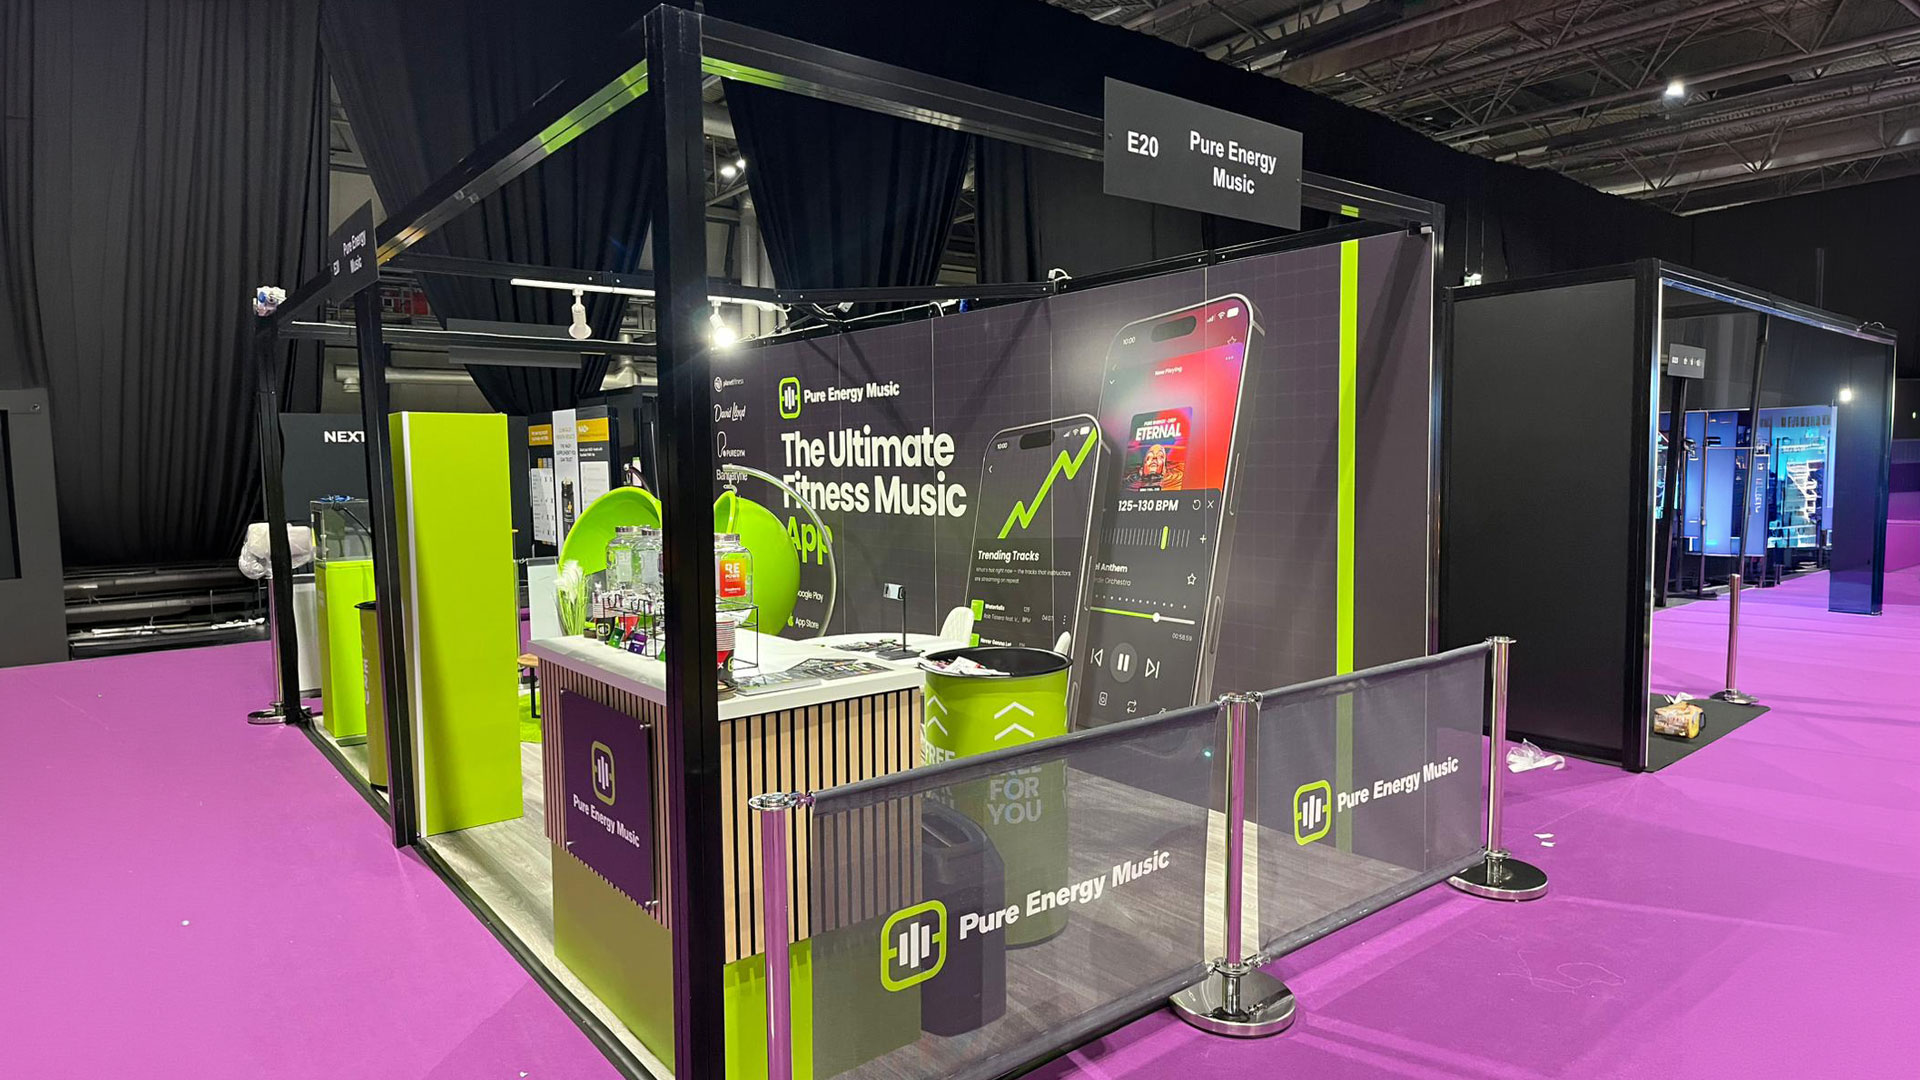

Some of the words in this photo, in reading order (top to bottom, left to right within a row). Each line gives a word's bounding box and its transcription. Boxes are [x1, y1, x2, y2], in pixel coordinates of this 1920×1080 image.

[1127, 130, 1159, 158] E20
[1189, 130, 1225, 158] Pure
[1228, 140, 1277, 175] Energy
[1213, 166, 1256, 194] Music
[803, 389, 826, 403] Pure
[828, 385, 864, 403] Energy
[866, 381, 900, 398] Music
[713, 403, 732, 422] David
[731, 402, 746, 421] Lloyd
[1135, 422, 1182, 441] ETERNAL
[781, 431, 825, 468] The
[828, 424, 955, 468] Ultimate
[782, 470, 870, 512] Fitness
[874, 470, 967, 517] Music
[1155, 500, 1179, 512] BPM
[787, 516, 833, 565] App
[978, 550, 1012, 563] Trending
[1012, 550, 1040, 561] Tracks
[1101, 563, 1129, 573] Anthem
[1105, 577, 1131, 586] Orchestra
[798, 590, 812, 600] oogle
[813, 591, 824, 603] Play
[795, 617, 806, 628] App
[805, 619, 820, 629] Store
[990, 777, 1040, 801] FOR
[1337, 787, 1369, 813] Pure
[1373, 771, 1420, 799] Energy
[1423, 756, 1459, 783] Music
[573, 793, 590, 815] Pure
[590, 804, 615, 834] Energy
[616, 820, 640, 848] Music
[987, 799, 1042, 825] YOU
[959, 903, 1020, 940] Pure
[1025, 874, 1106, 917] Energy
[1111, 850, 1170, 888] Music
